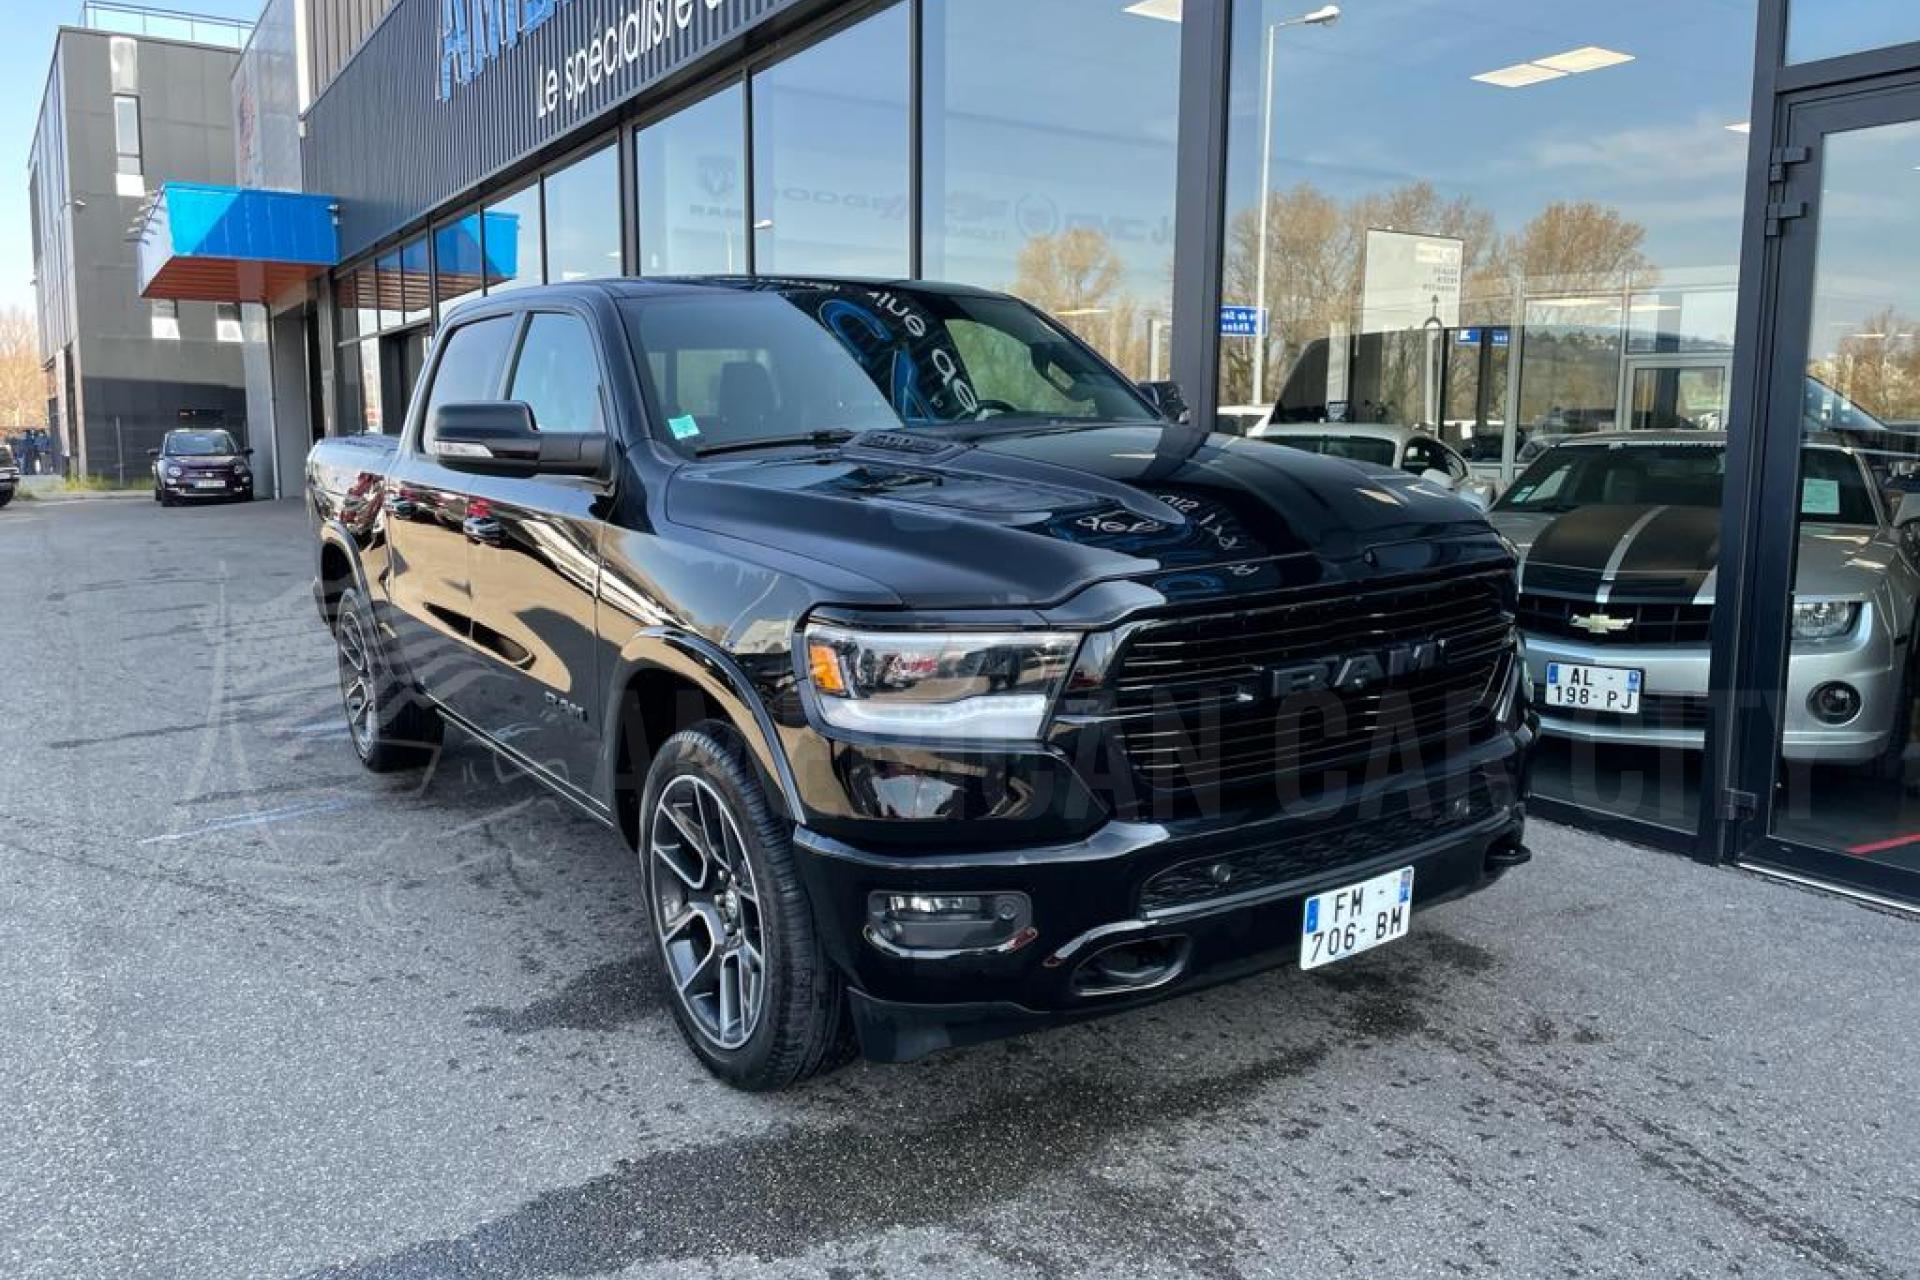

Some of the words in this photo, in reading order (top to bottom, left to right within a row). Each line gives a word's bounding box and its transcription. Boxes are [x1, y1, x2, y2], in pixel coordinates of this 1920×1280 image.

[538, 62, 558, 118] Le
[1272, 638, 1447, 698] RAM
[1571, 667, 1594, 686] AL
[1606, 690, 1632, 710] PJ
[1334, 886, 1364, 923] FM
[1375, 904, 1403, 940] BM
